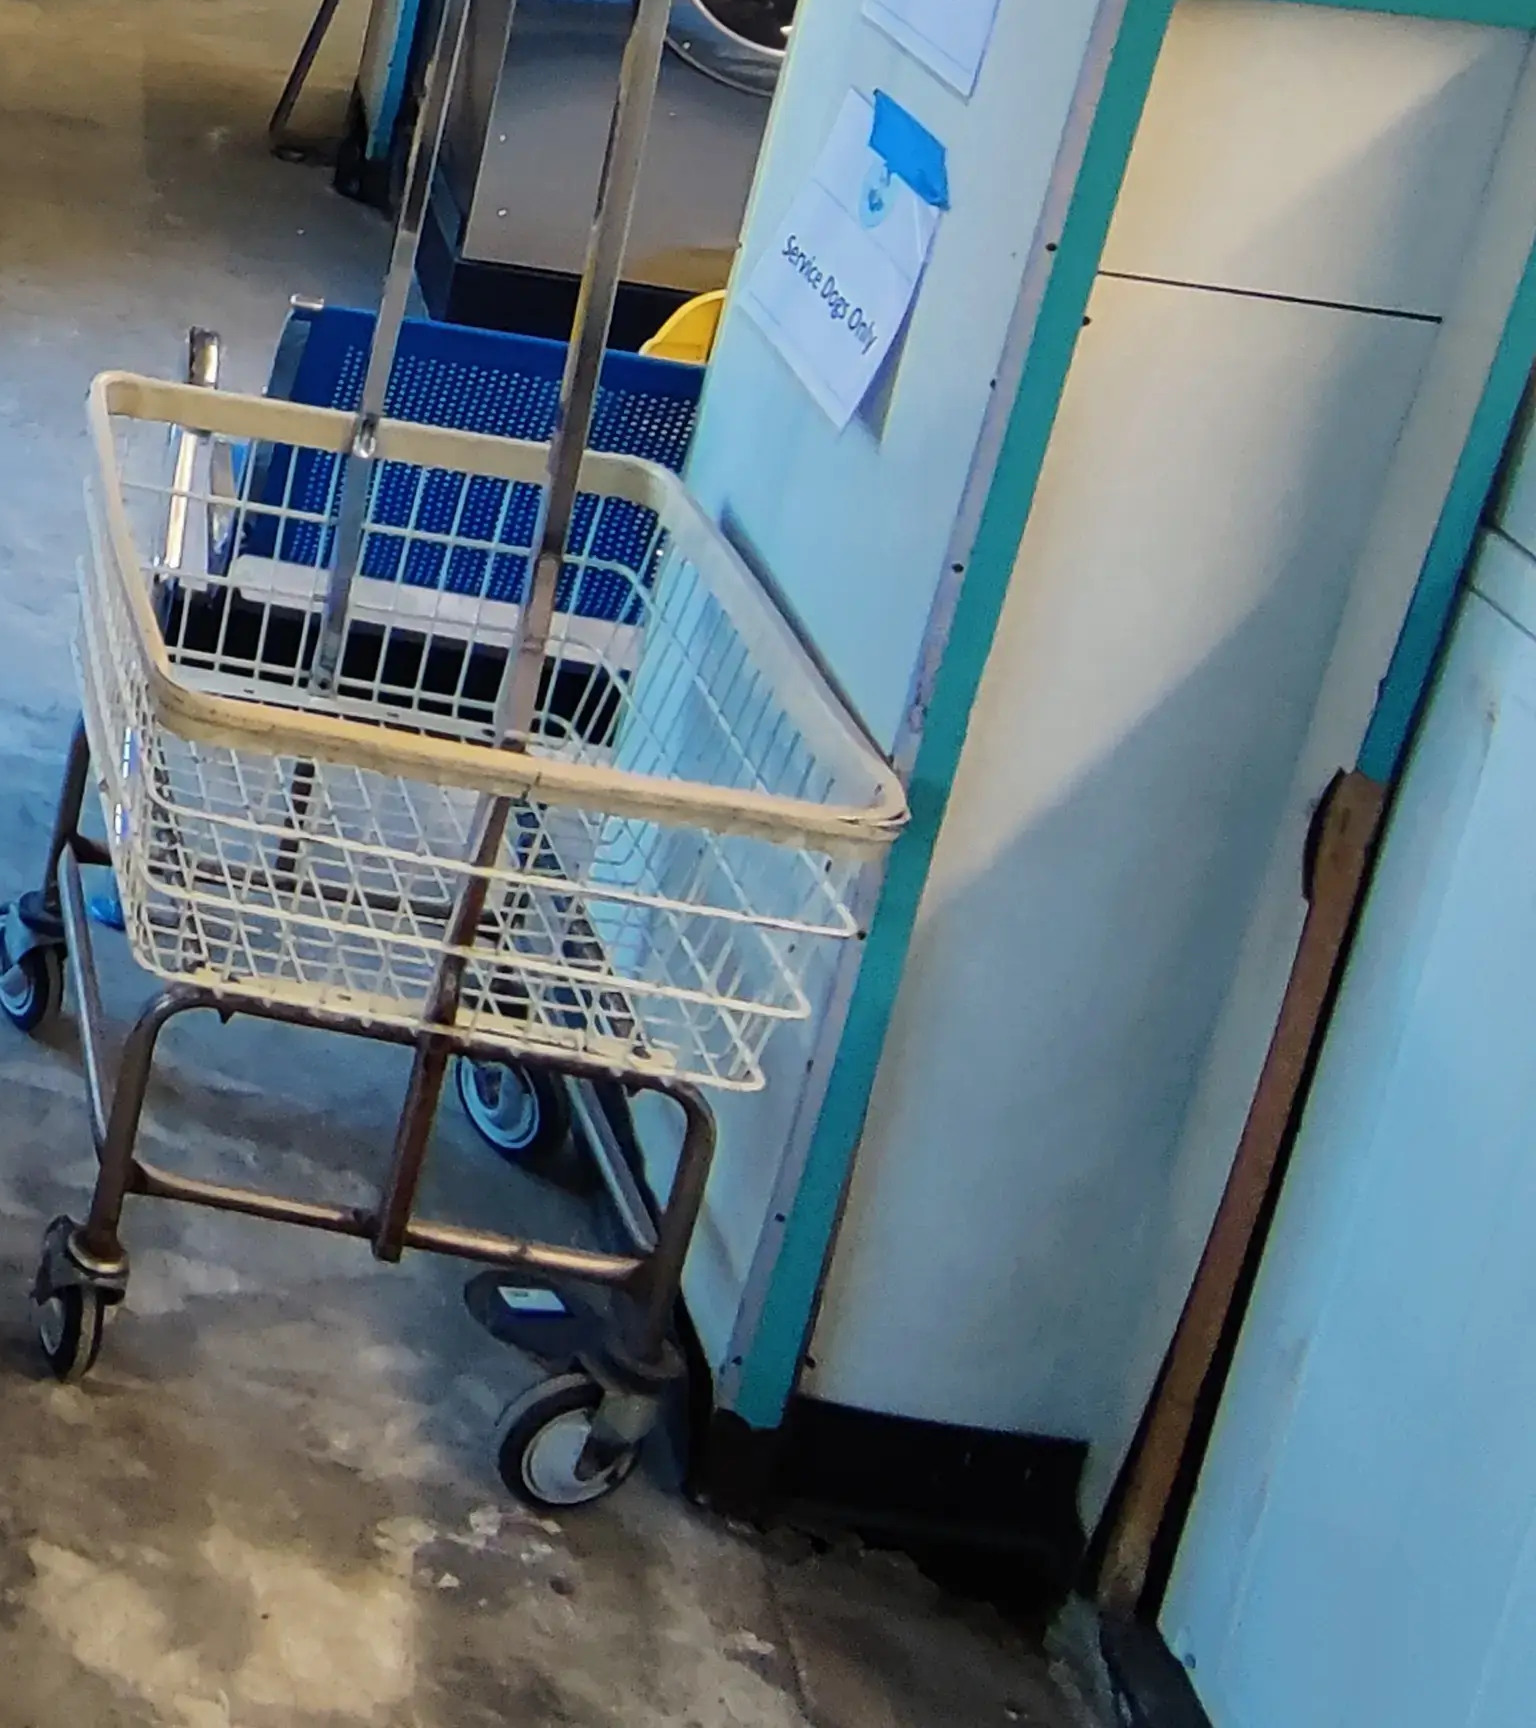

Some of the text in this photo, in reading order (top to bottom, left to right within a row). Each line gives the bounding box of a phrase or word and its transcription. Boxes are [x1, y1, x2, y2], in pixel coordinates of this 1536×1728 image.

[781, 234, 879, 356] Service Dogs Only
